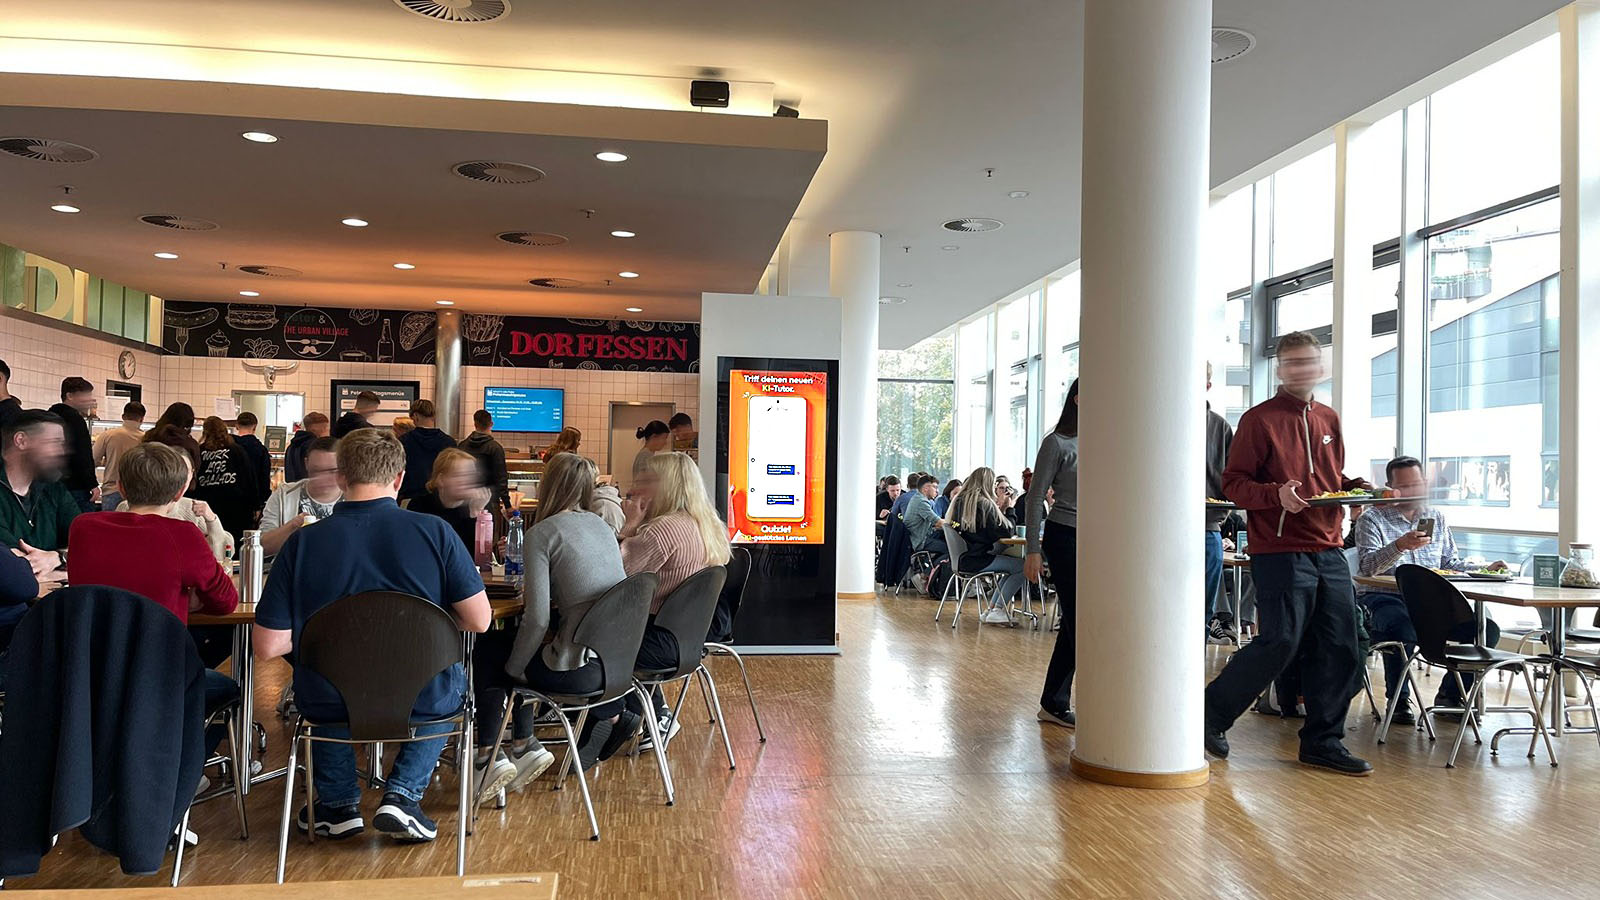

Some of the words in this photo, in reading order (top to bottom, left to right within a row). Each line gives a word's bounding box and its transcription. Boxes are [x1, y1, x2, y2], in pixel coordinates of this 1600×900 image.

[318, 314, 326, 324] &
[284, 325, 296, 335] THE
[297, 326, 320, 335] URBAN
[322, 327, 349, 336] VILLAGE
[509, 330, 688, 361] DORFESSEN
[743, 374, 760, 383] Triff
[761, 375, 787, 384] deinen
[201, 448, 230, 461] WORK
[205, 460, 227, 474] LIFE
